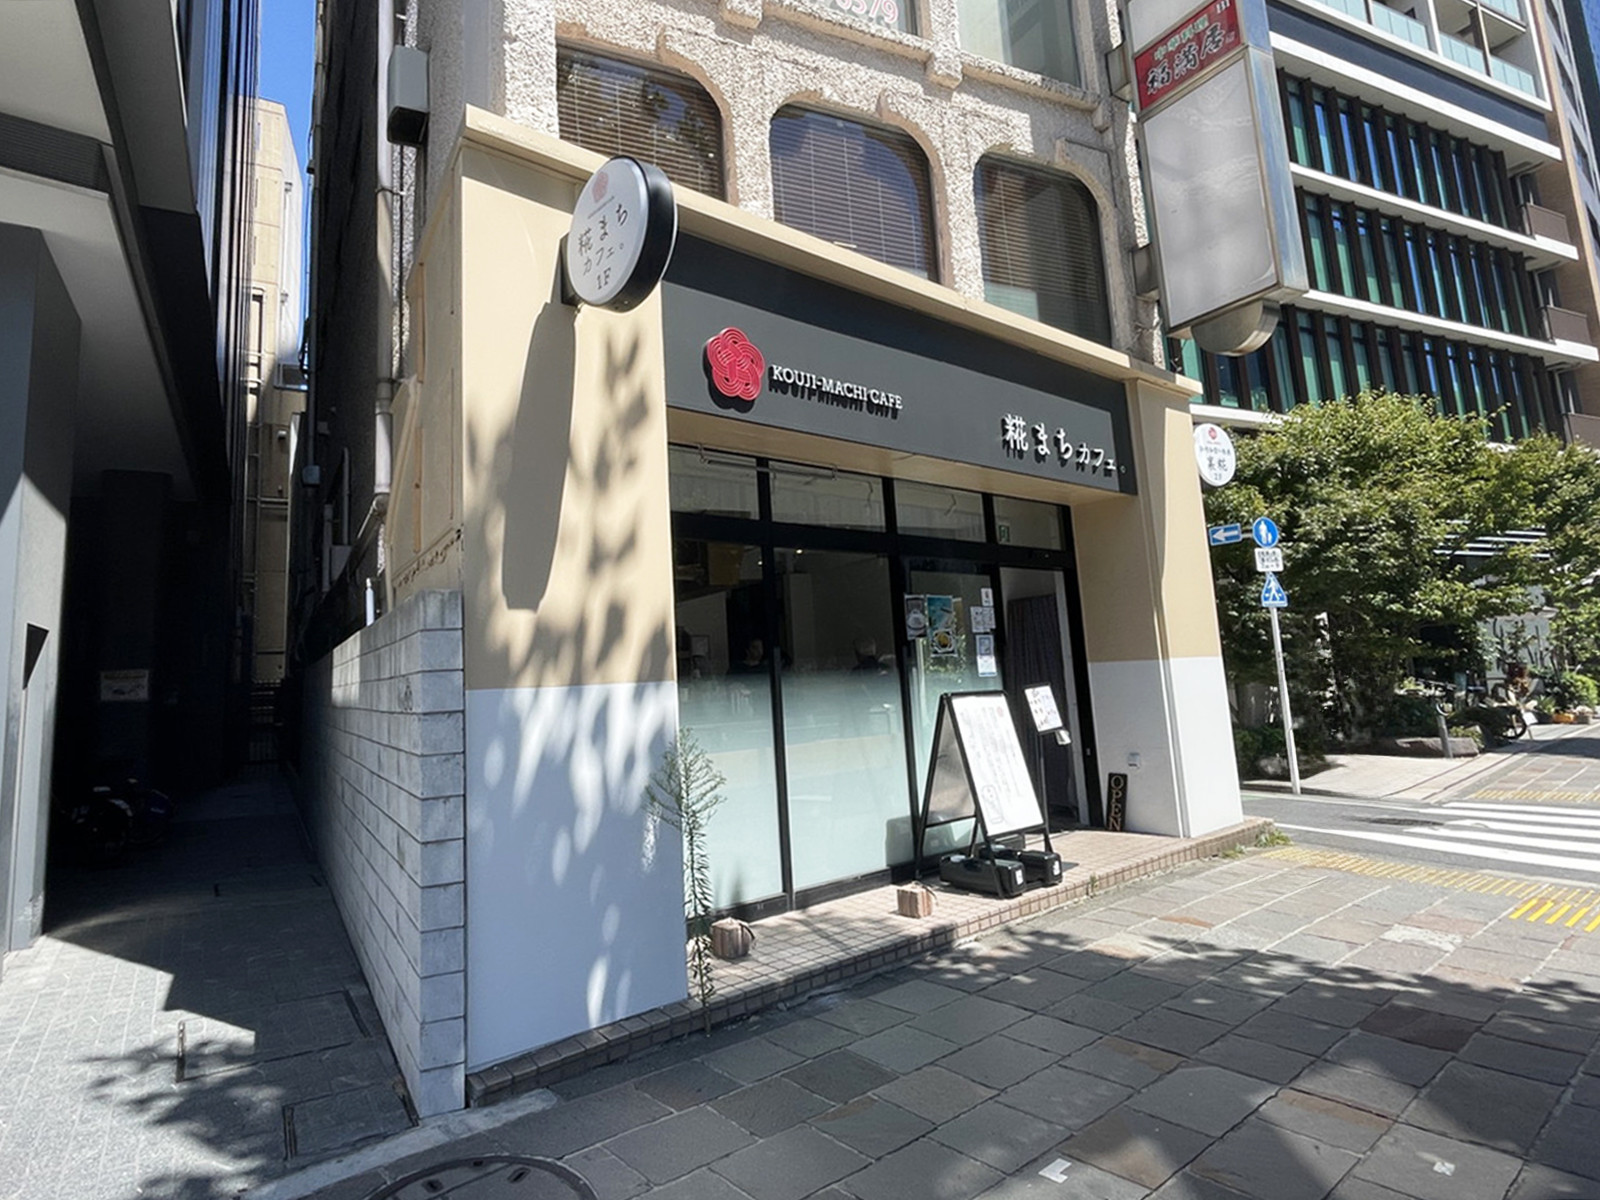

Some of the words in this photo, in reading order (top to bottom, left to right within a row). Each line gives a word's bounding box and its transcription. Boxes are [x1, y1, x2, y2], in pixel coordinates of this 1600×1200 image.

[771, 364, 869, 401] KOUJI-MACHI
[867, 388, 904, 410] CAFE
[1109, 775, 1124, 831] OPEN
